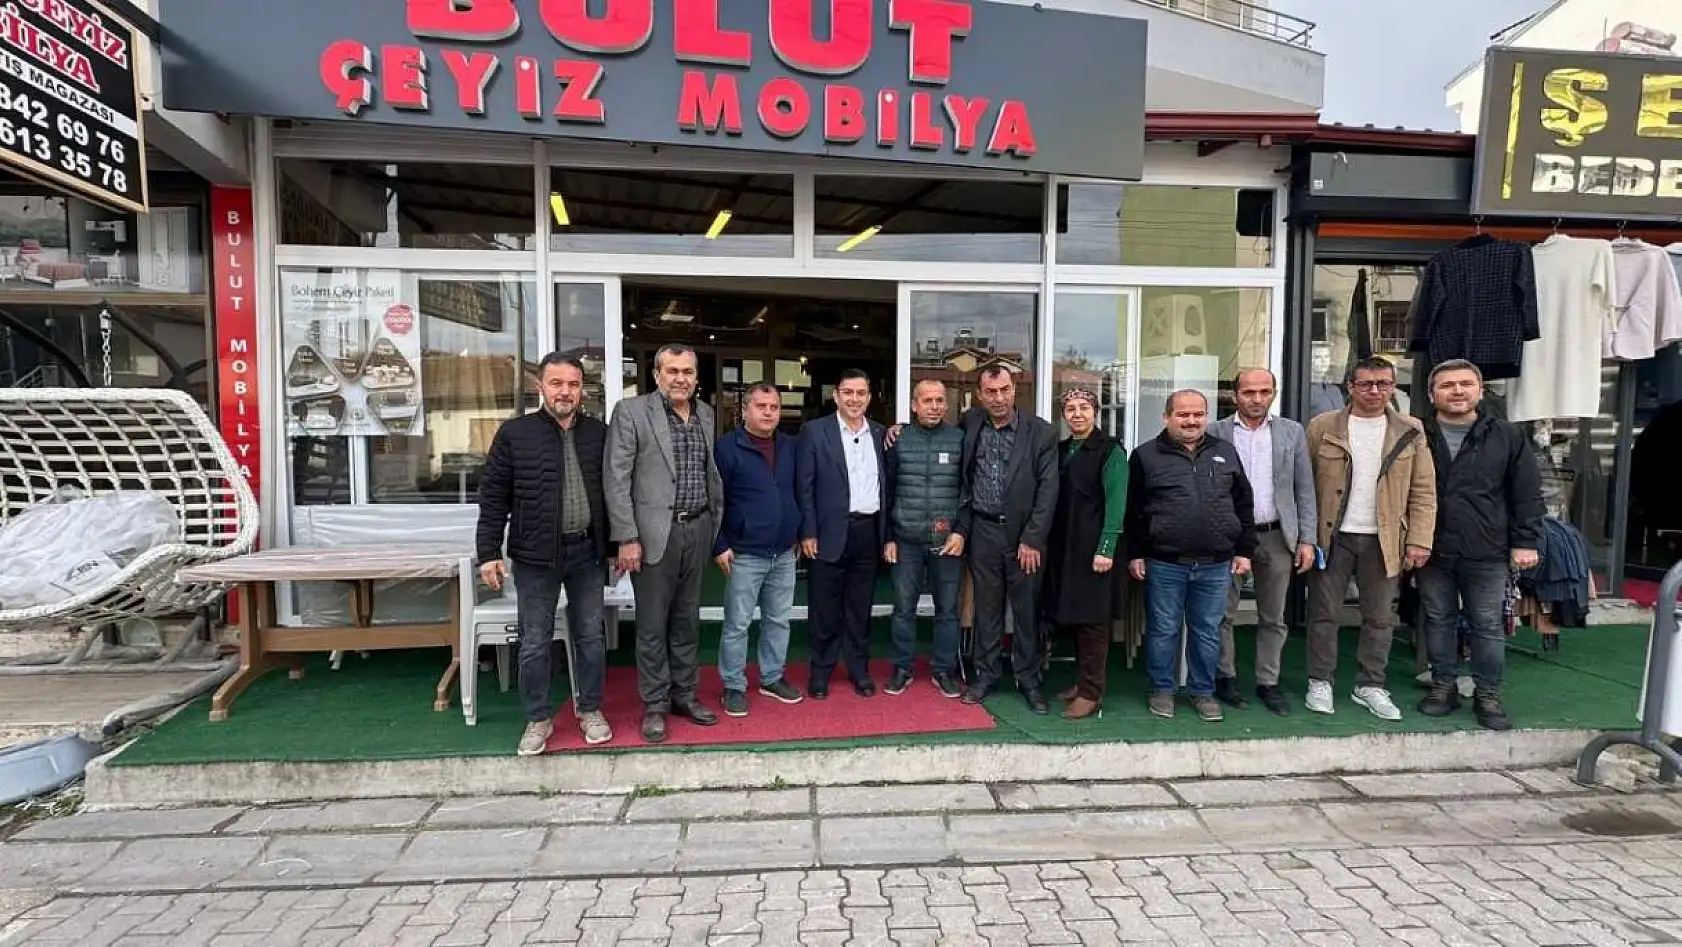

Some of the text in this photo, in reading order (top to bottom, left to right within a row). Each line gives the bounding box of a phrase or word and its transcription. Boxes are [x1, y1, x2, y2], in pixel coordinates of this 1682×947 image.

[0, 2, 100, 94] İLYA
[57, 113, 90, 146] 69
[95, 131, 125, 164] 76
[319, 39, 1037, 157] ÇEYİZ MOBİLYA
[0, 116, 127, 192] 613 35 78
[1531, 153, 1682, 198] BEBE
[226, 210, 243, 310] BULUT
